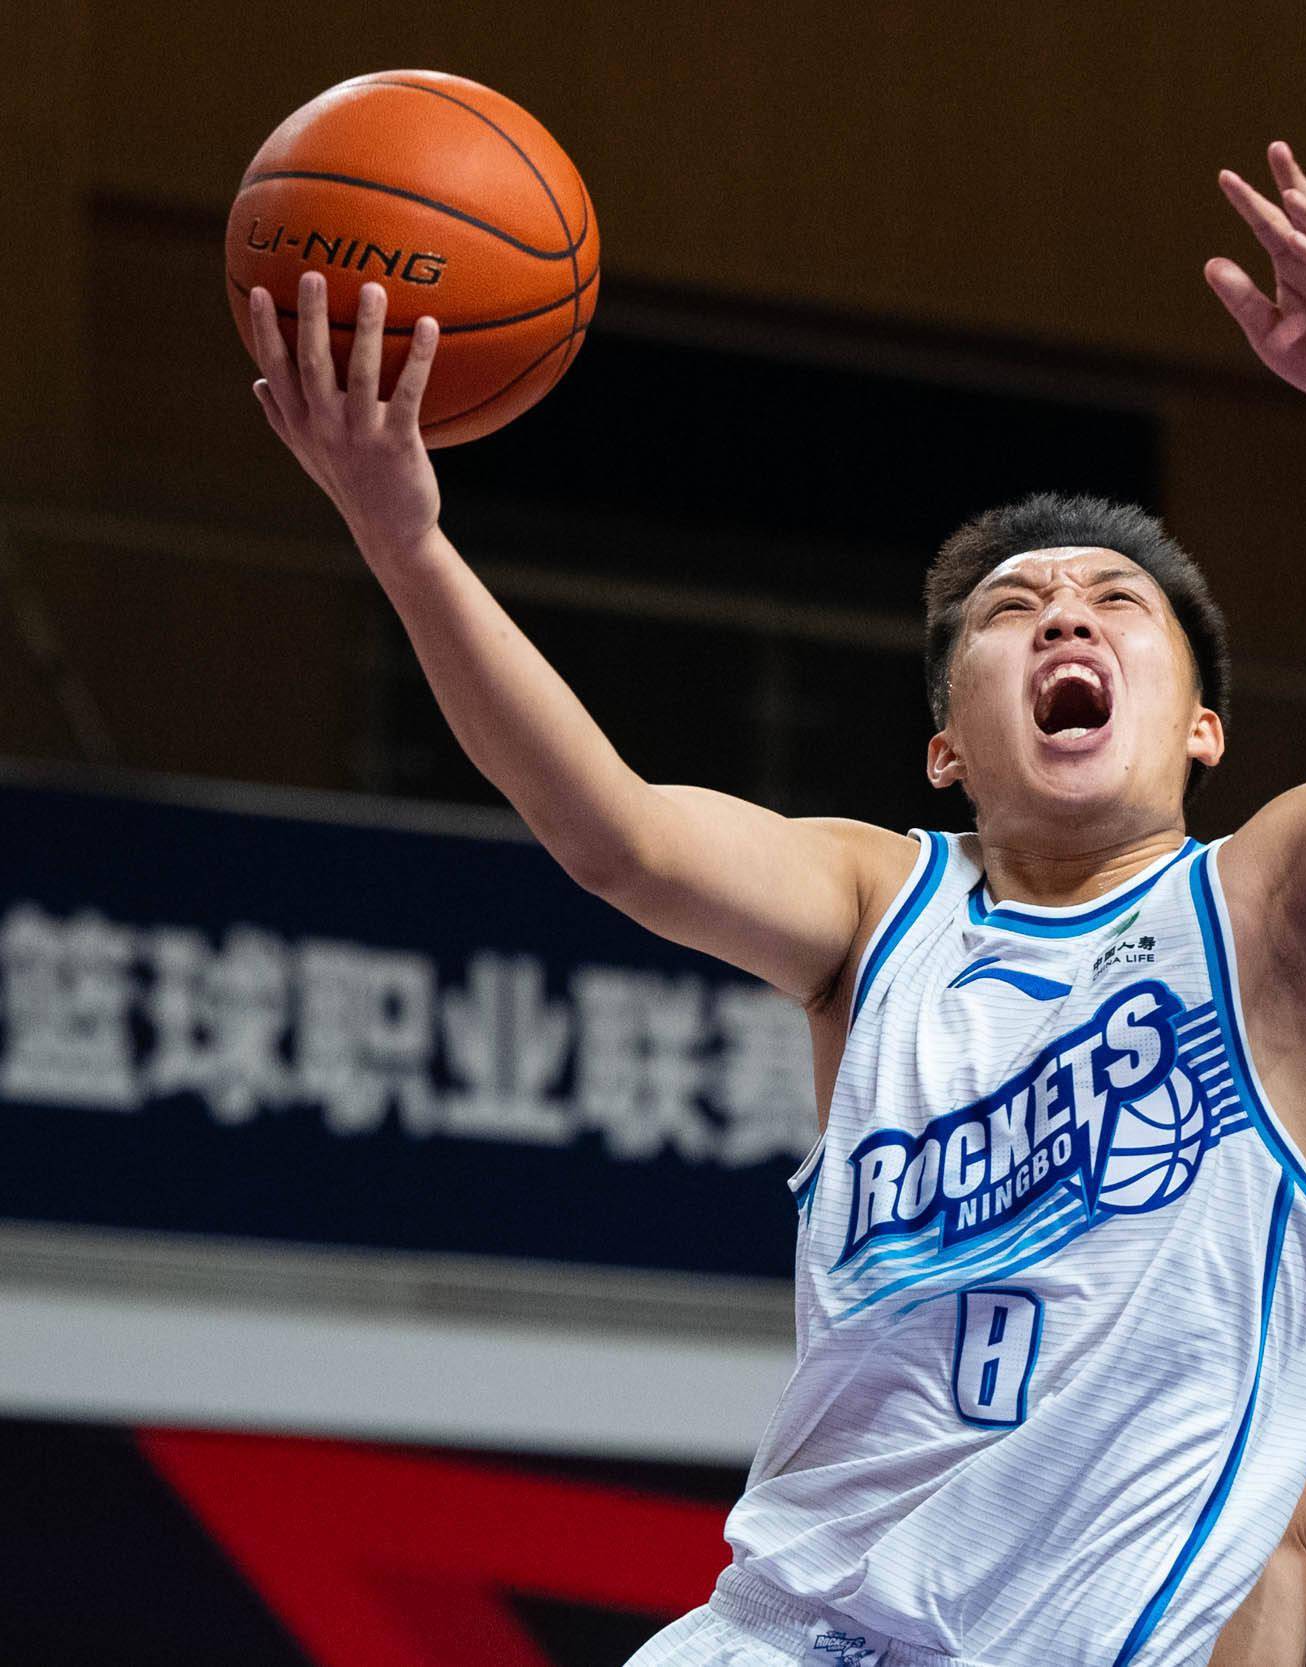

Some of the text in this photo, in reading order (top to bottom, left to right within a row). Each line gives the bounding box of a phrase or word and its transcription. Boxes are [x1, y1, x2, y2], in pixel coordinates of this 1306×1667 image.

[247, 217, 448, 285] LI-NING
[1126, 953, 1155, 963] LIFE
[850, 991, 1172, 1245] ROCKETS
[957, 1131, 1073, 1232] NINGBO
[953, 1287, 1045, 1430] 8
